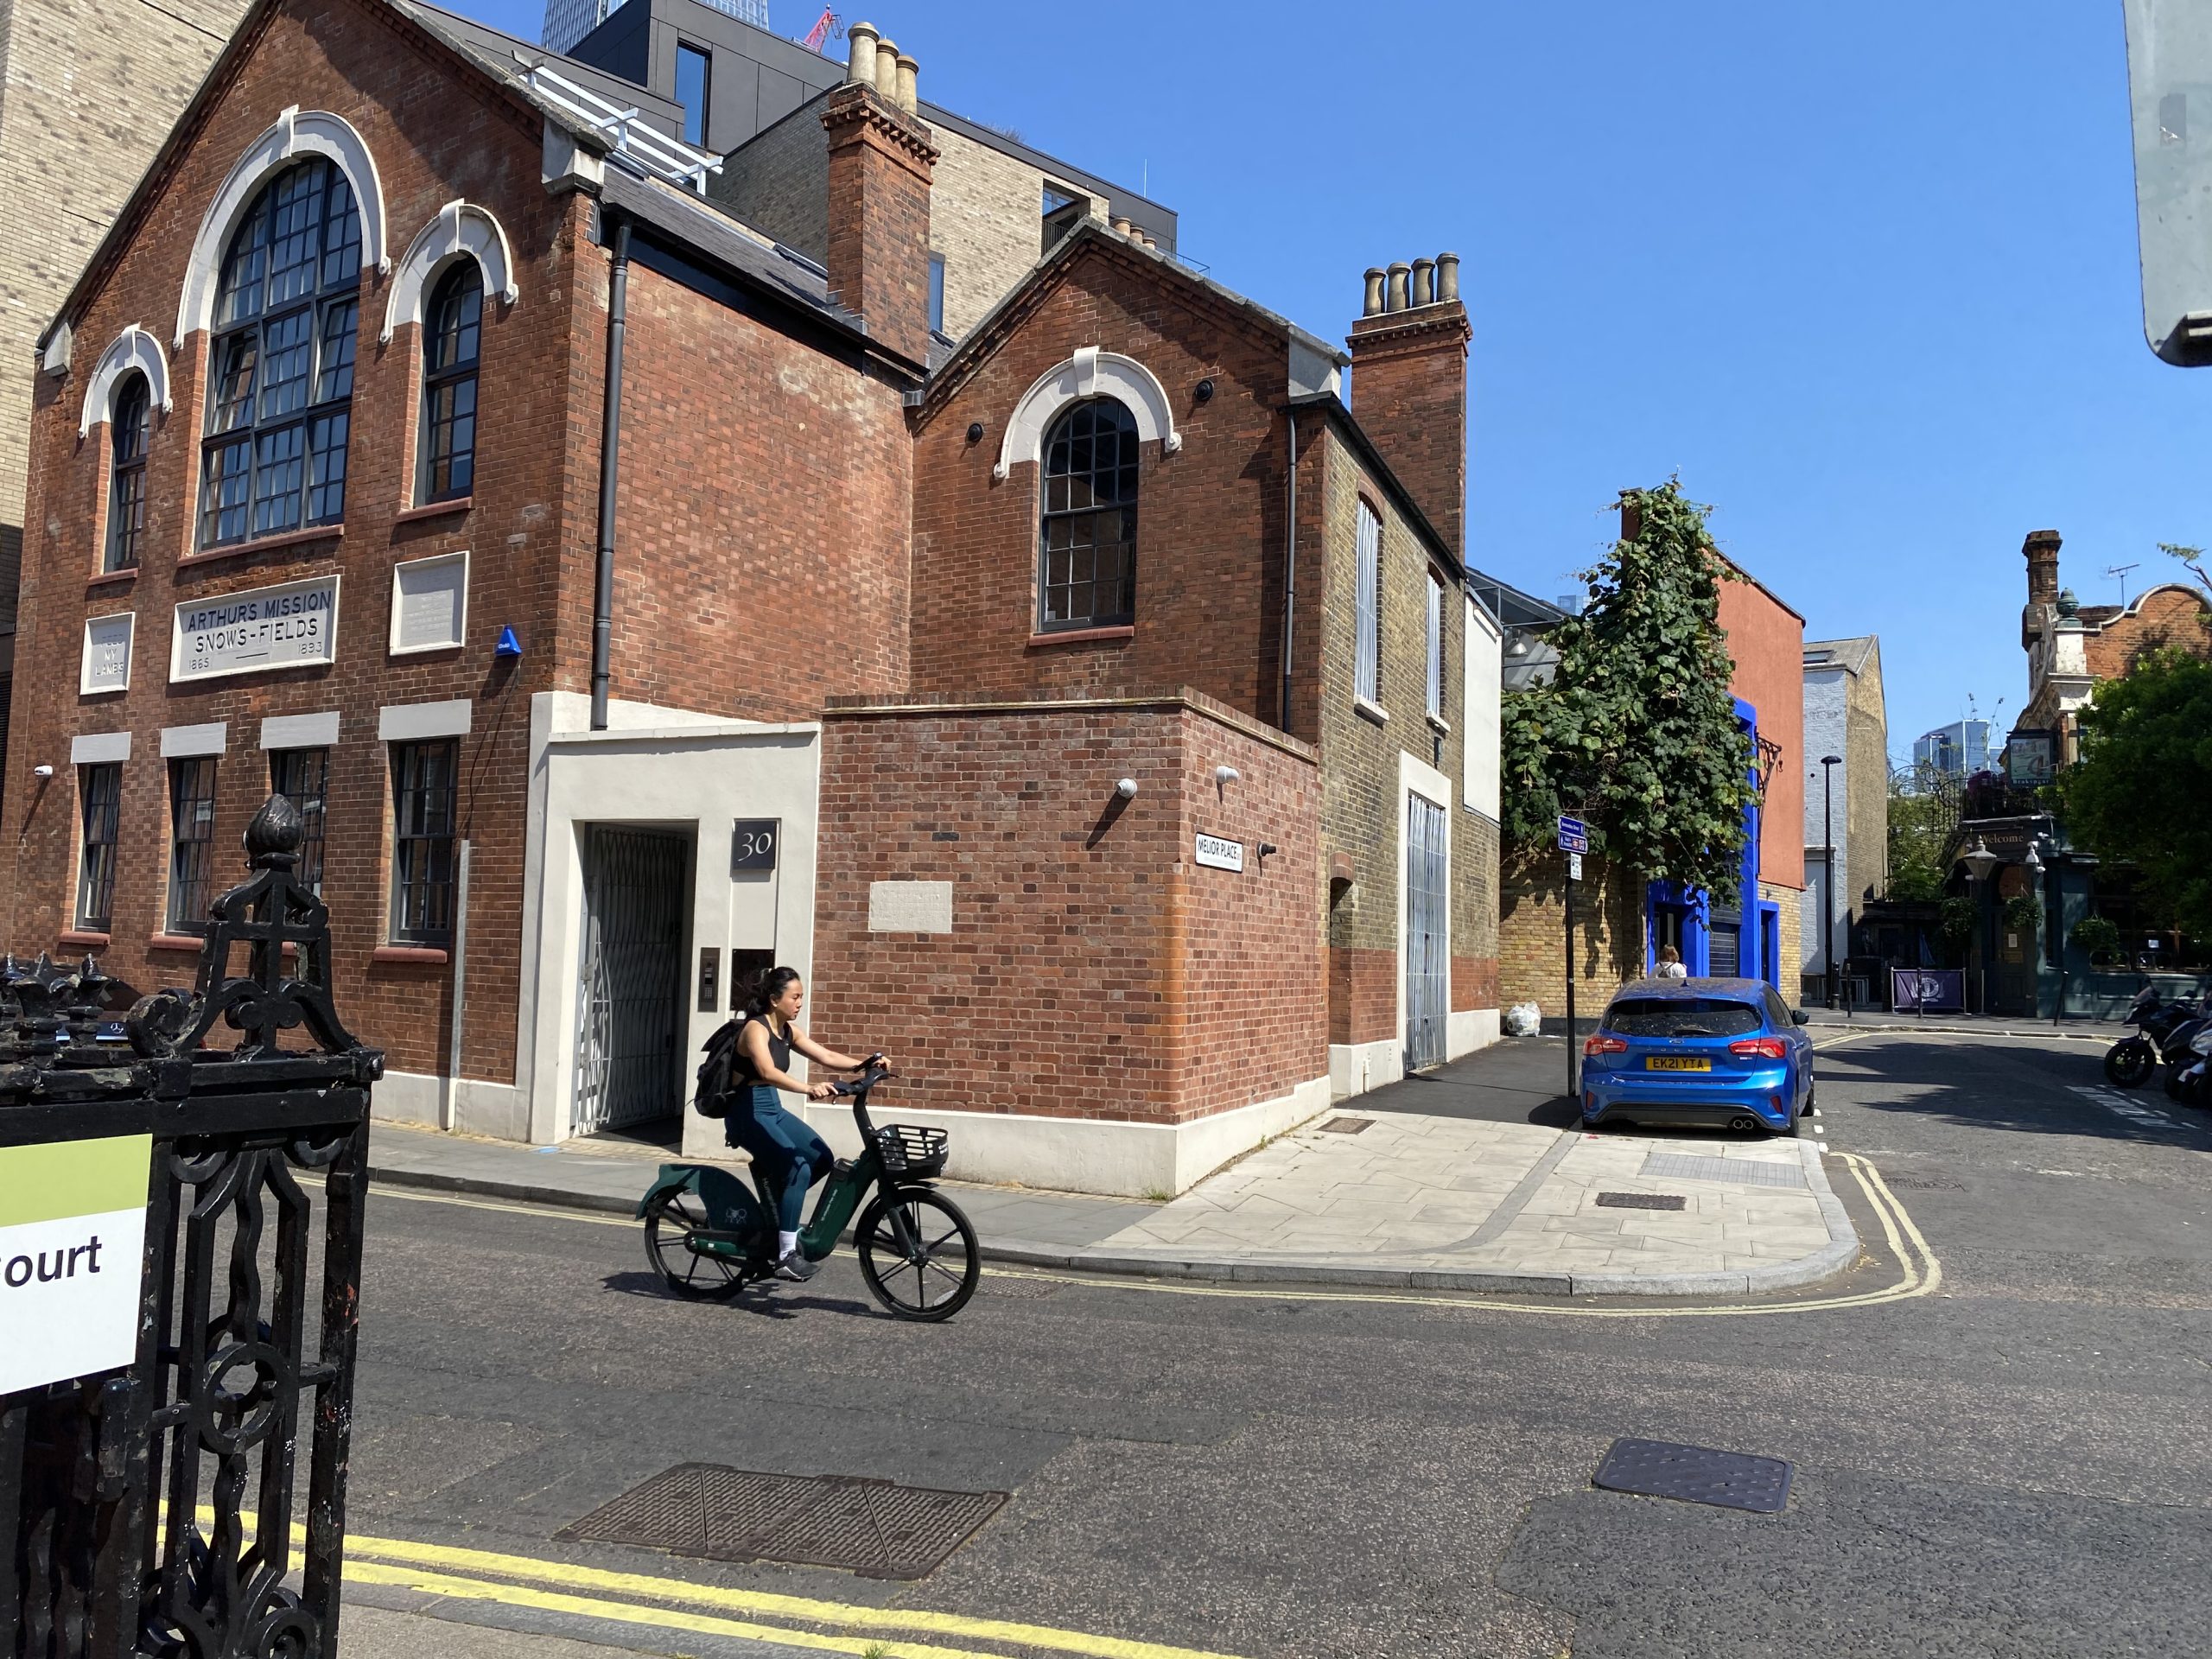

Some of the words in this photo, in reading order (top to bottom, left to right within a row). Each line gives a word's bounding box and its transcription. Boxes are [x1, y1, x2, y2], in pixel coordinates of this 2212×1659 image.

[188, 602, 257, 632] ARTHUR'S
[264, 590, 332, 619] MISSION
[297, 641, 322, 654] 1893
[188, 658, 210, 670] 1865
[737, 832, 772, 861] 30
[1982, 834, 2024, 844] Welcome
[1198, 839, 1219, 855] MELIOR
[1221, 843, 1236, 859] PLACE
[1653, 1058, 1679, 1068] EK21
[1681, 1058, 1704, 1069] YTA
[0, 1236, 102, 1287] ourt
